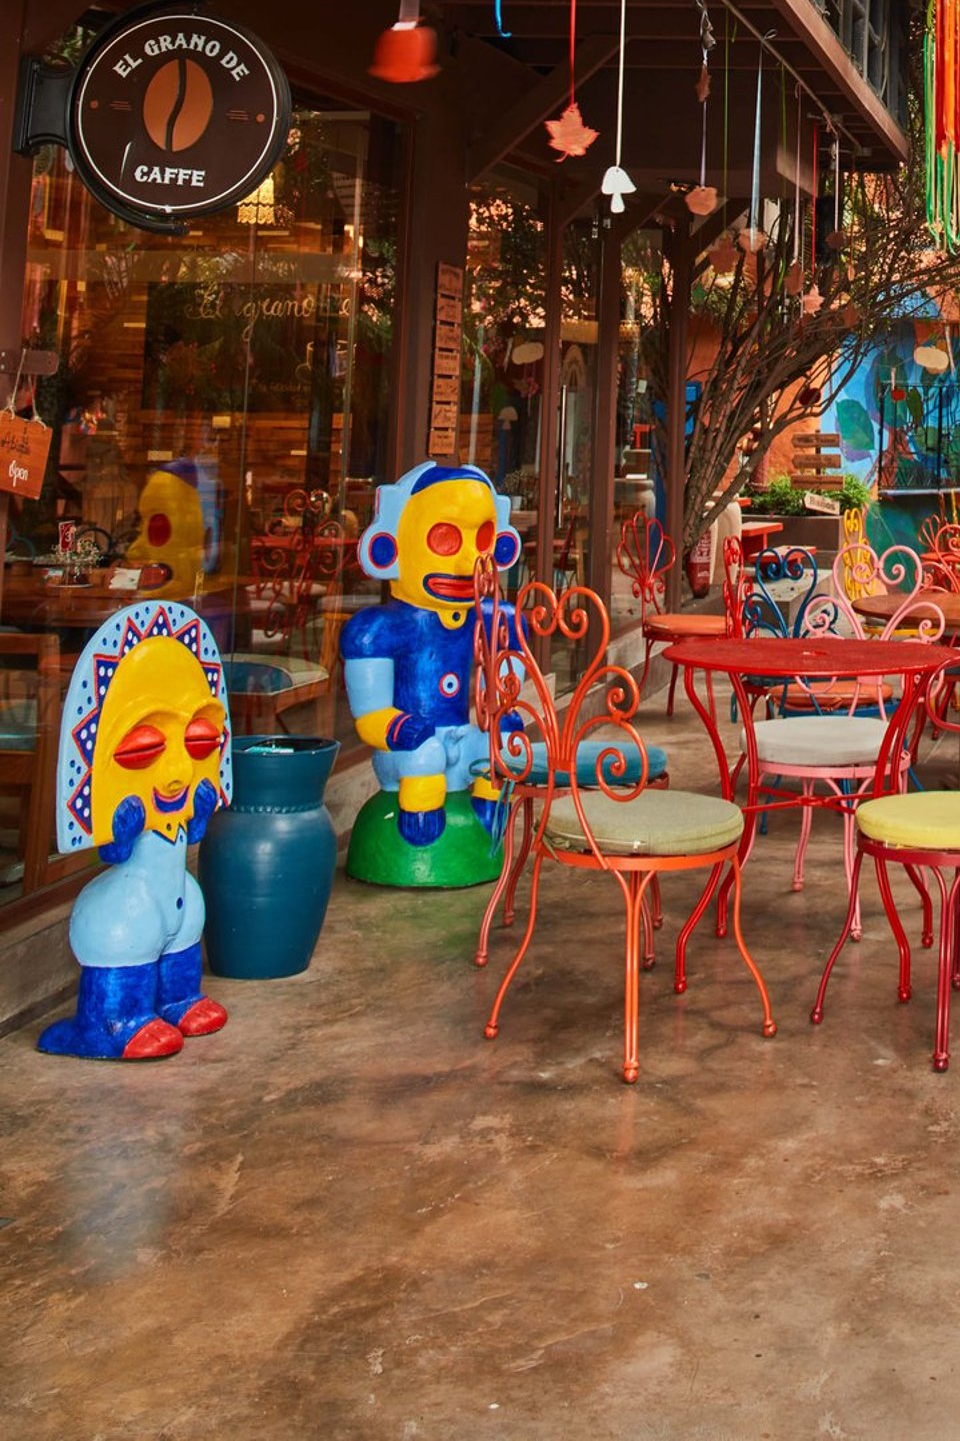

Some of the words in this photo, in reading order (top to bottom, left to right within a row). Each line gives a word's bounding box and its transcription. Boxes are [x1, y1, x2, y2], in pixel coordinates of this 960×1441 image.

[112, 53, 143, 78] EL
[144, 32, 221, 57] GRANO
[220, 50, 250, 81] DE
[134, 165, 205, 187] CAFFE
[234, 296, 316, 341] grano
[8, 459, 29, 487] Open
